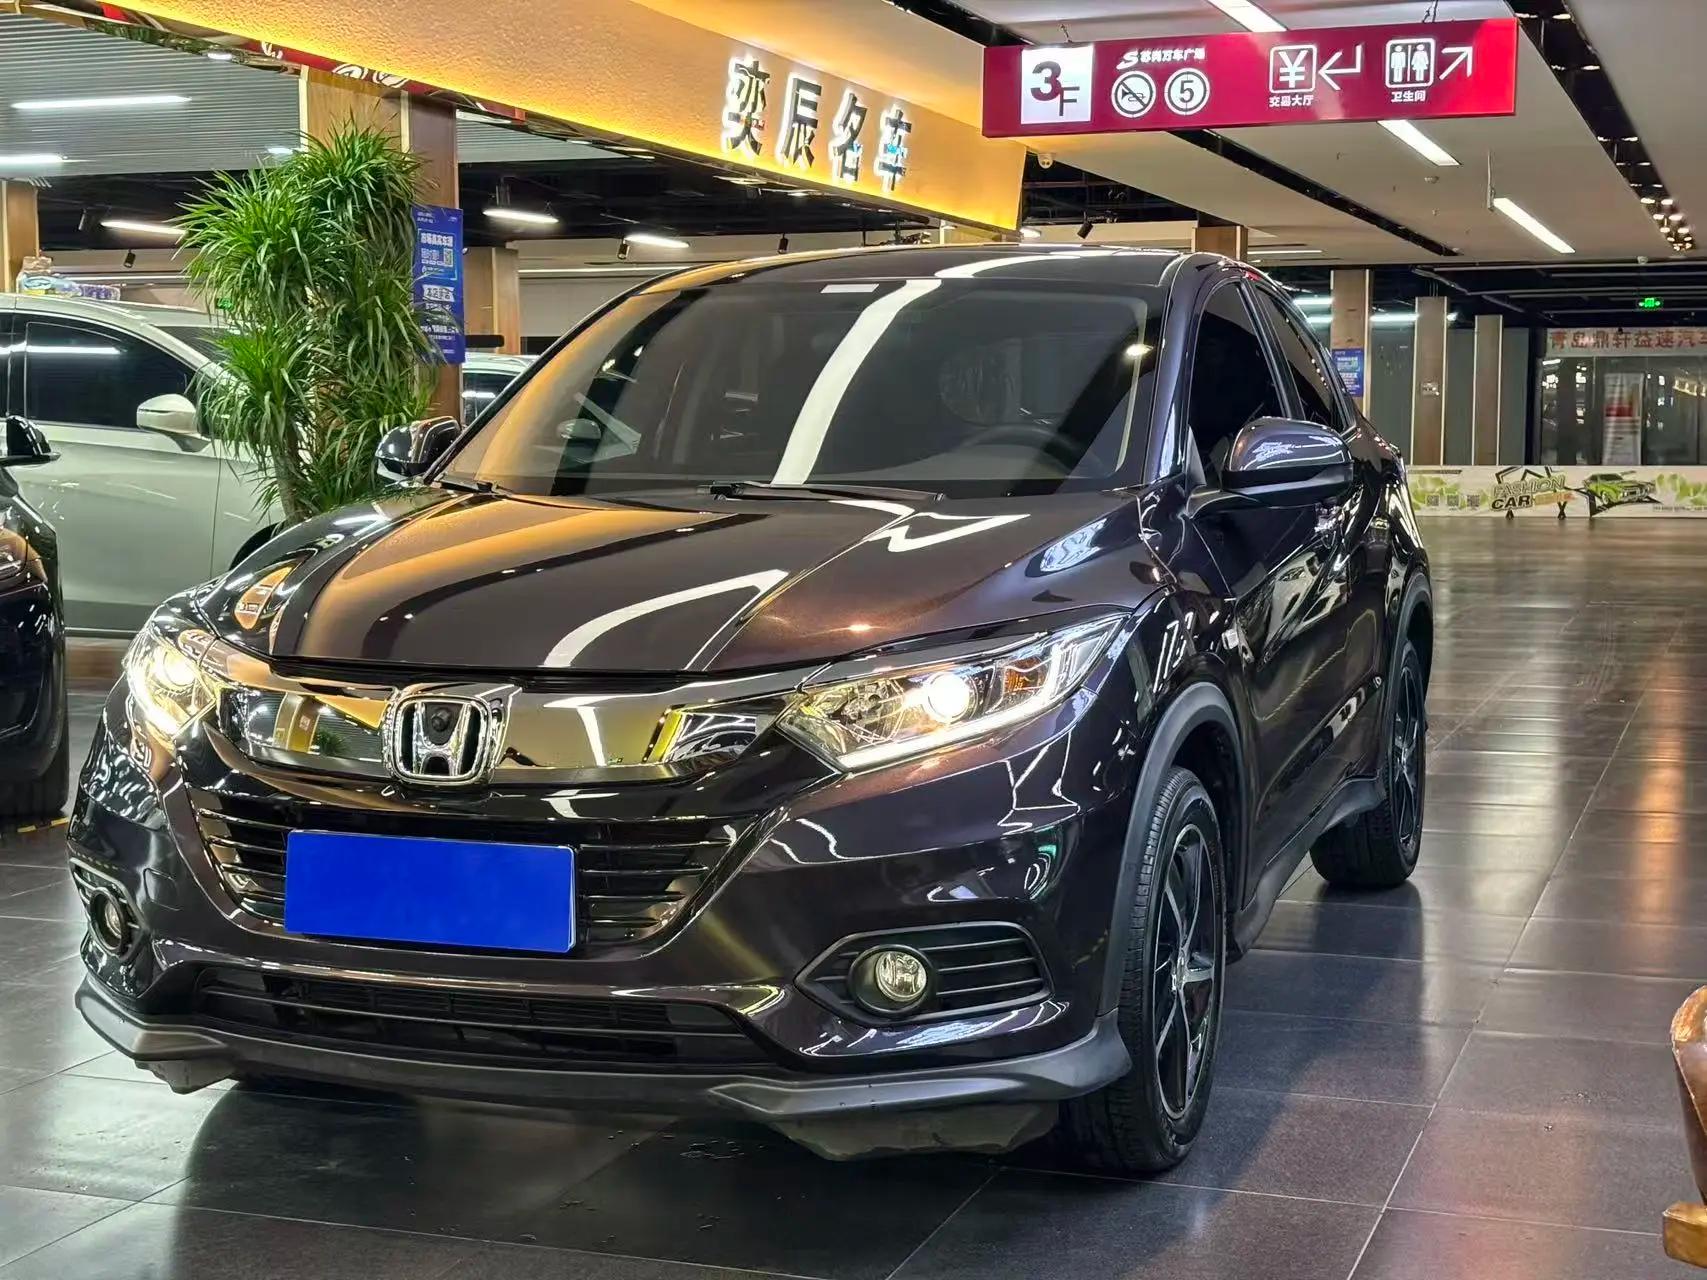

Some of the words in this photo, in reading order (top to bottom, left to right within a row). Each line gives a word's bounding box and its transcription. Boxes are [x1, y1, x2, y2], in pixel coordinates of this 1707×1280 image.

[1179, 80, 1194, 103] 5
[1269, 94, 1314, 107] 交易大厅
[1391, 90, 1426, 103] 卫生间
[724, 59, 912, 192] 奕辰名车
[1493, 475, 1565, 498] FASHION
[1491, 495, 1531, 510] CAR
